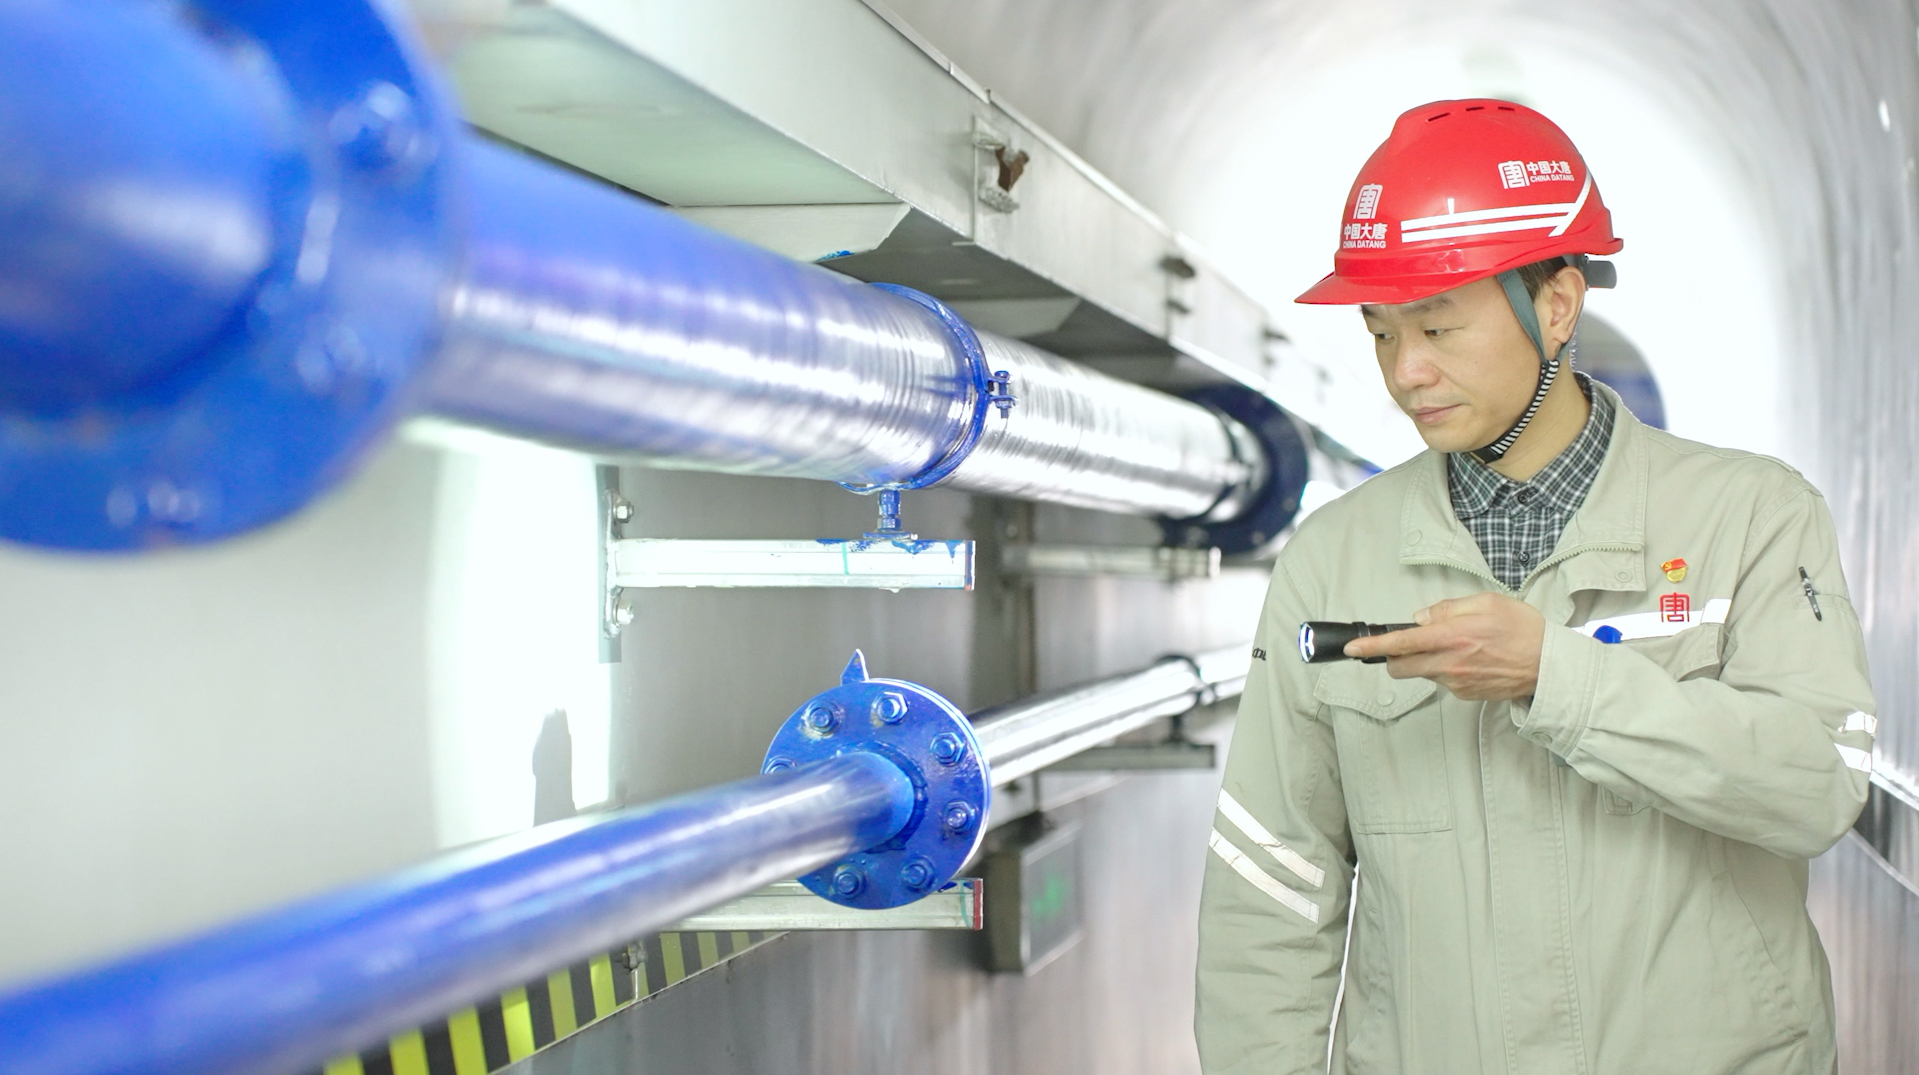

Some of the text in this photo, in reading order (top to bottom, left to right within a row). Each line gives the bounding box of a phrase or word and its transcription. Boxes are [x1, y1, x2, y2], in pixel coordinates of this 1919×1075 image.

[1526, 160, 1572, 176] 中国大唐
[1530, 174, 1575, 183] CHINA DATANG
[1343, 222, 1388, 240] 中国大唐
[1357, 240, 1387, 249] DATANG
